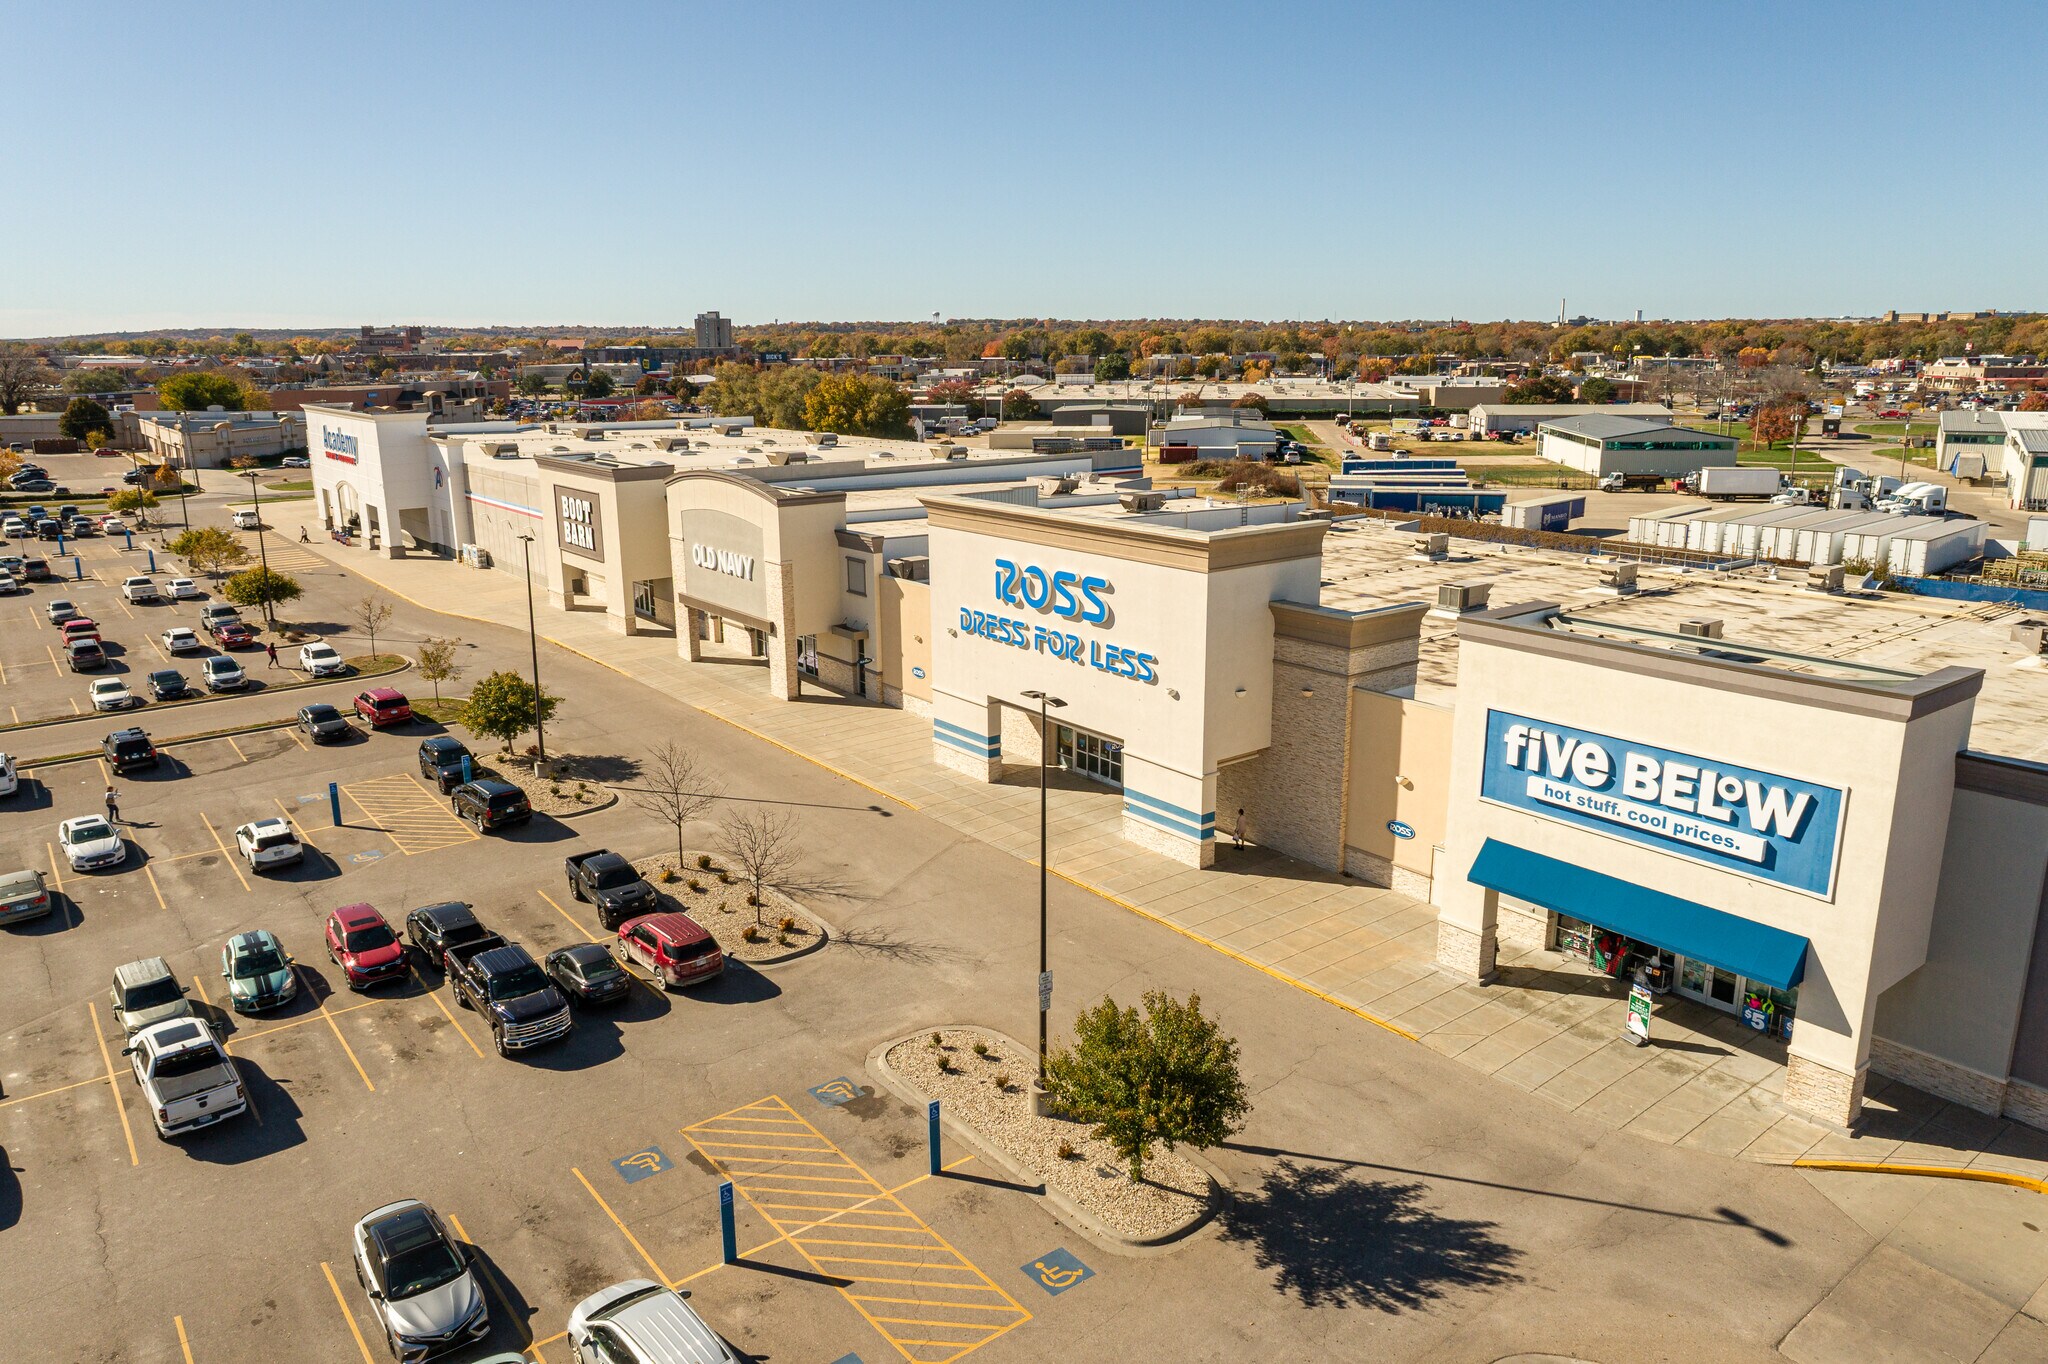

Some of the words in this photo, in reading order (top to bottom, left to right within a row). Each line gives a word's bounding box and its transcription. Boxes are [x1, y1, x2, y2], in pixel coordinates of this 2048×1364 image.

[323, 425, 358, 464] Academy
[561, 495, 592, 524] BOOT
[563, 520, 595, 550] BARN
[692, 543, 717, 571] OLD
[717, 549, 754, 581] NAVY
[994, 557, 1112, 625] ROSS
[959, 606, 1028, 648] DRESS
[1033, 625, 1082, 663] FOR
[1090, 639, 1156, 683] LESS
[1389, 822, 1412, 837] ROSS
[1543, 783, 1572, 803] hot
[1576, 791, 1622, 818] stuff.
[1627, 807, 1668, 831] cool
[1672, 820, 1742, 851] prices.
[1744, 1009, 1766, 1030] $5
